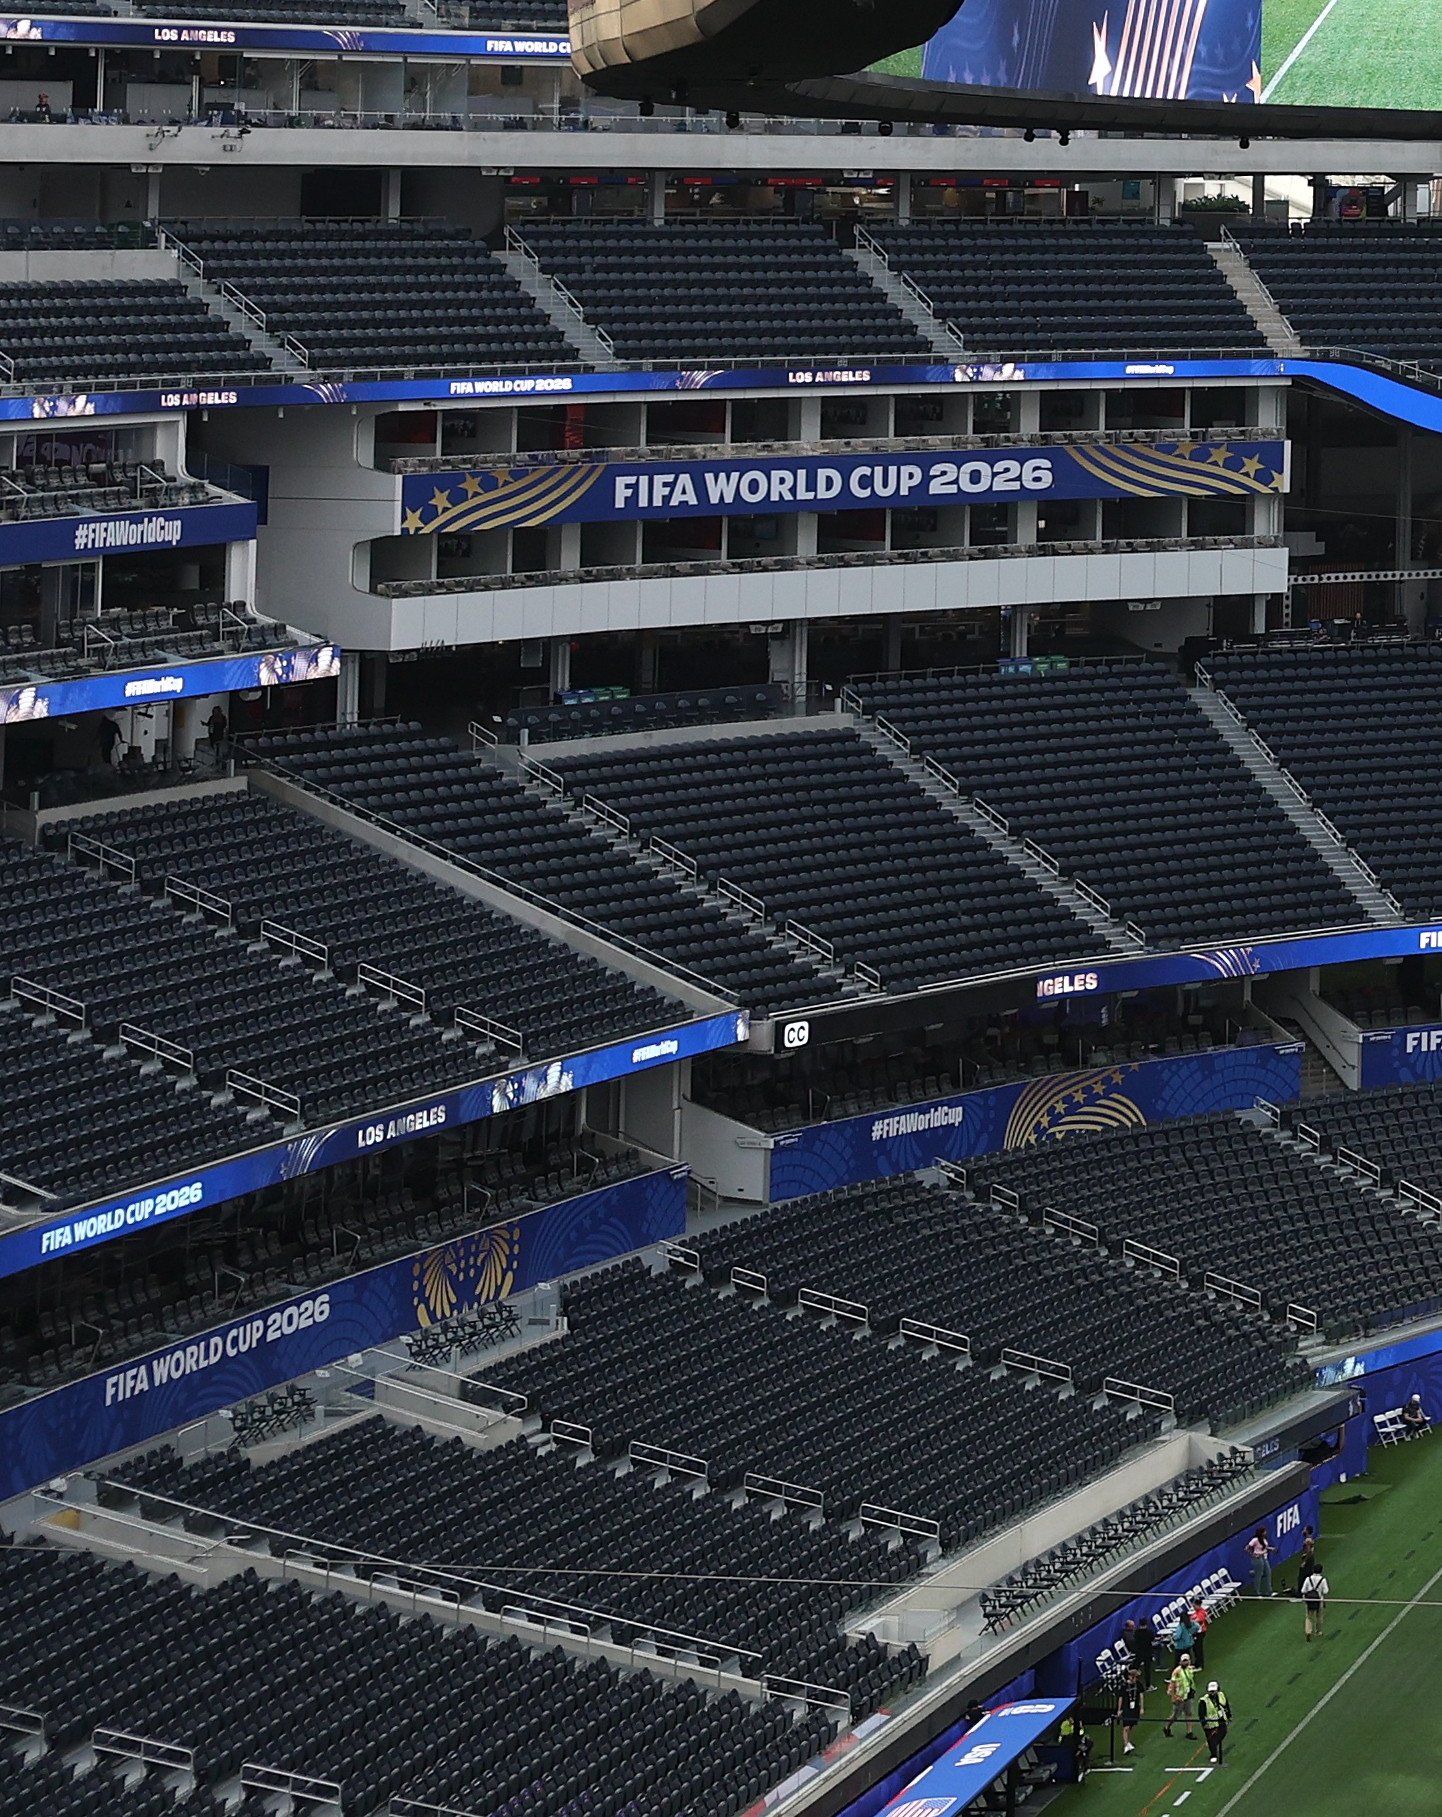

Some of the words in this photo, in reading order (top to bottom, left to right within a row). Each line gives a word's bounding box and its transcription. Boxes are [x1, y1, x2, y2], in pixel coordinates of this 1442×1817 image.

[154, 28, 179, 41] LOS
[182, 29, 236, 43] ANGELES
[614, 473, 699, 509] FIFA
[704, 468, 843, 505] WORLD
[849, 464, 923, 499] CUP
[928, 458, 1053, 495] 2026
[74, 516, 182, 550] #FIFAWorldCup
[786, 1026, 806, 1044] CC
[358, 1123, 385, 1148] LOS
[386, 1105, 446, 1140] ANGELES
[871, 1105, 963, 1142] #FIFAWorldCup
[41, 1225, 73, 1254] FIFA
[73, 1208, 125, 1243] WORLD
[125, 1198, 155, 1225] CUP
[154, 1181, 203, 1216] 2026
[104, 1362, 150, 1407] FIFA
[150, 1336, 223, 1387] WORLD
[225, 1319, 264, 1357] CUP
[266, 1293, 330, 1343] 2026
[1276, 1503, 1301, 1538] FIFA
